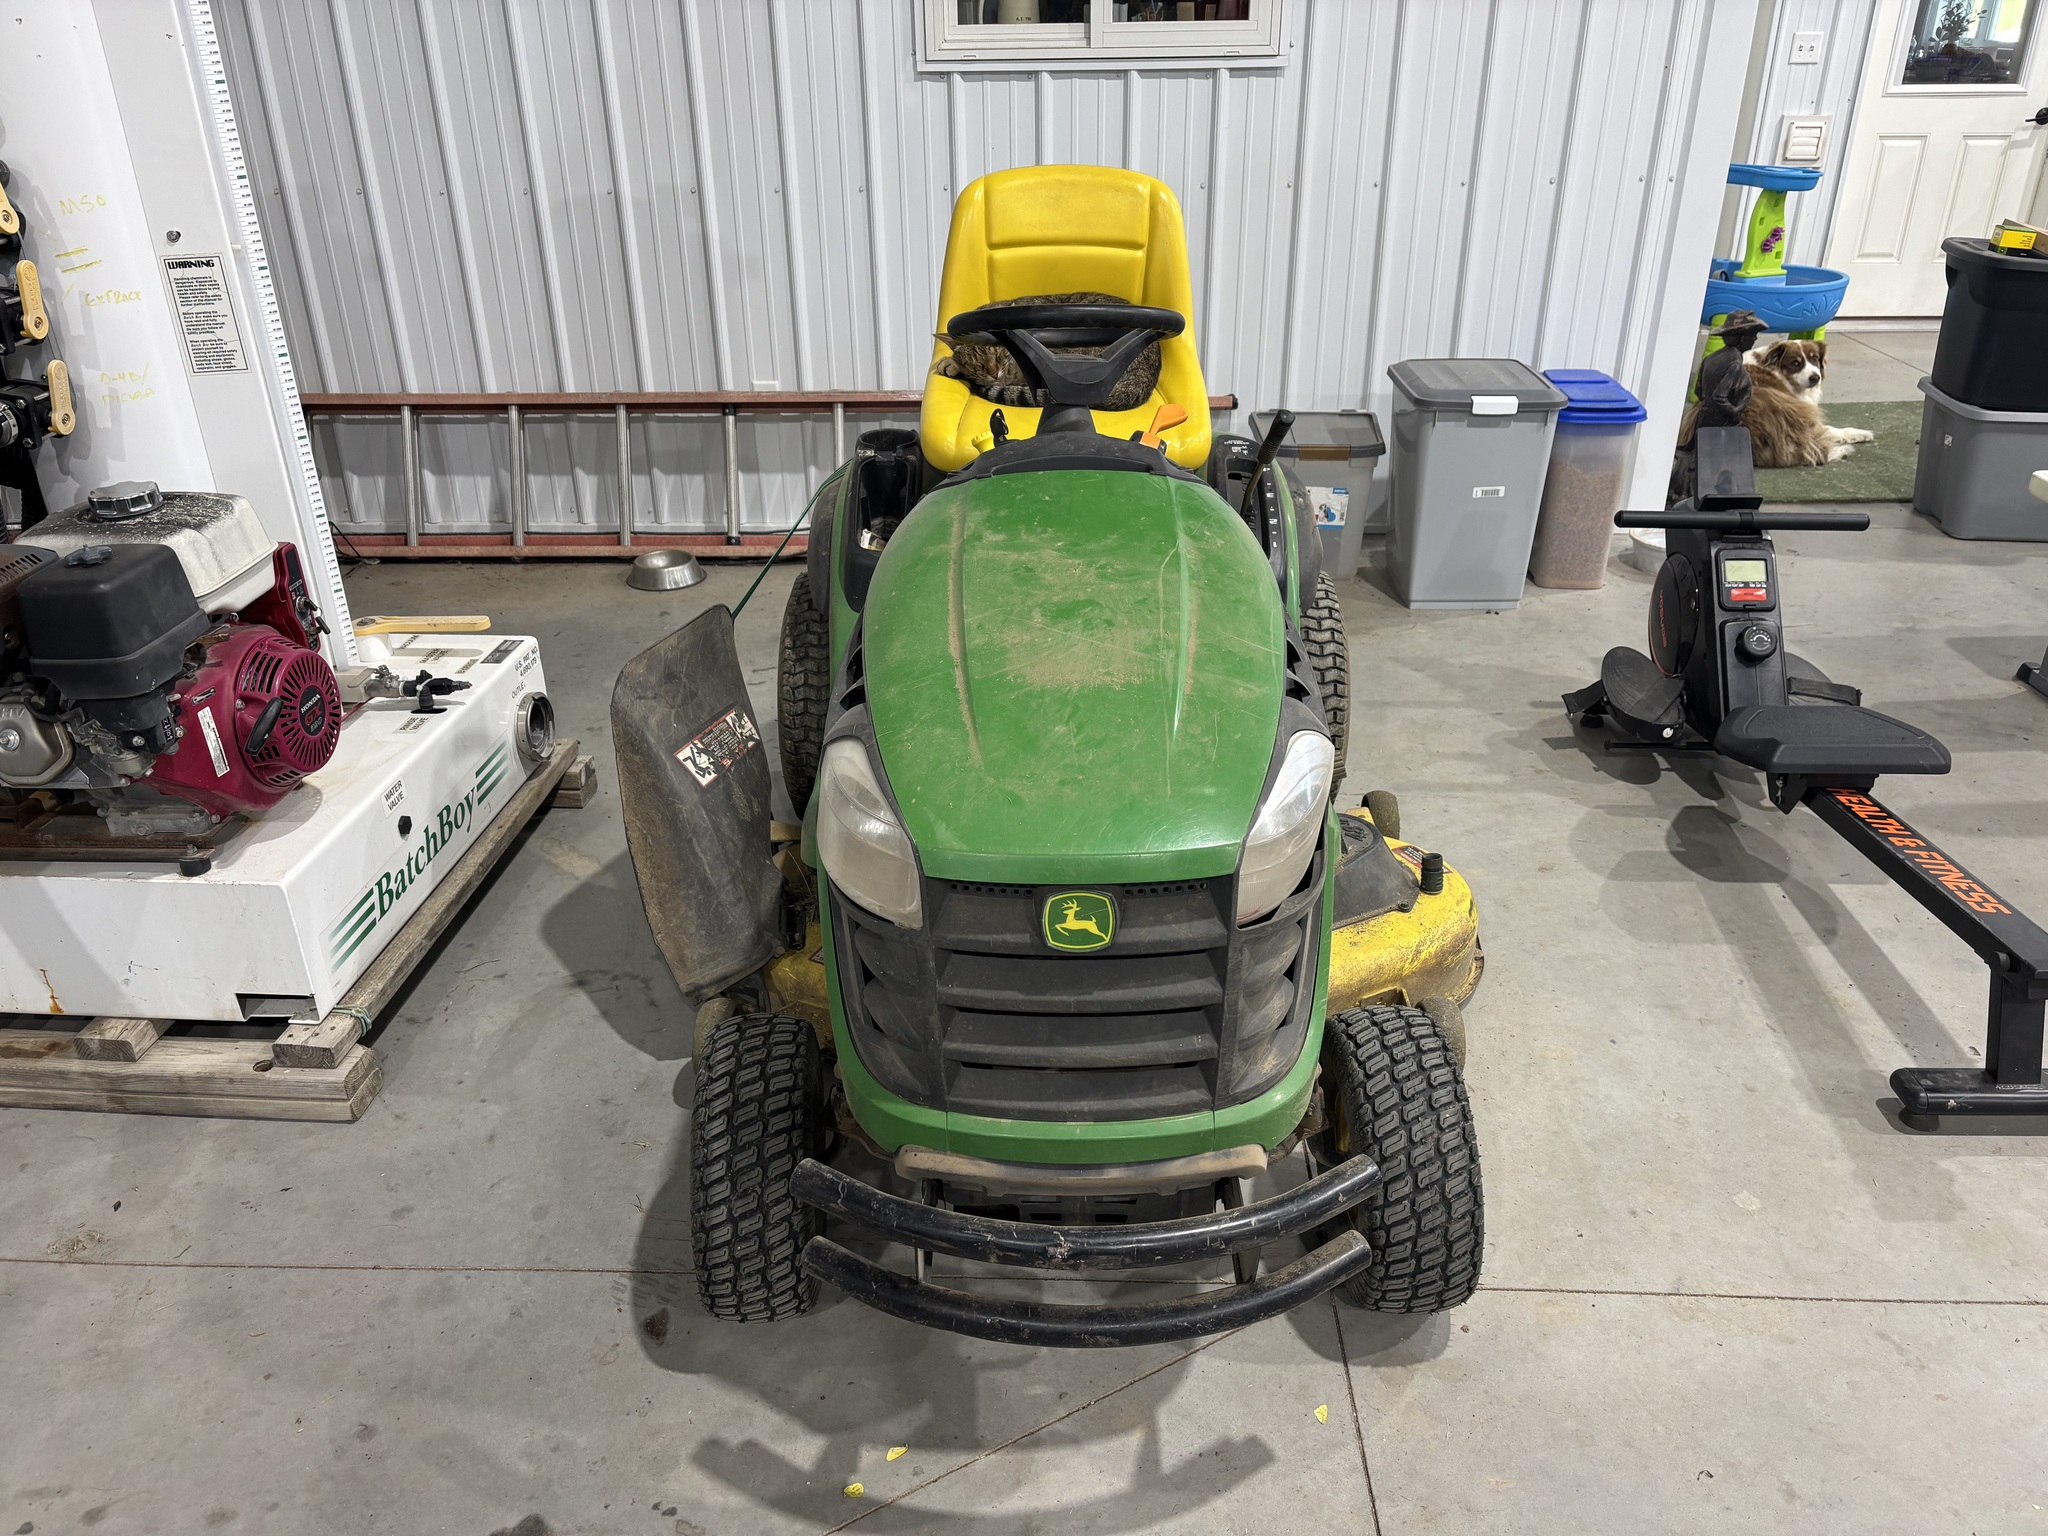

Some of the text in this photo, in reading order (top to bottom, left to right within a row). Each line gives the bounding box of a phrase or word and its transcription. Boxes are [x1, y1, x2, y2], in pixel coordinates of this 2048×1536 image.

[167, 260, 214, 270] WARNING
[300, 693, 321, 713] HONDA
[304, 701, 323, 727] GX
[384, 779, 403, 802] WATER
[387, 790, 405, 811] VALVE
[374, 786, 476, 922] BatchBoy
[1825, 787, 2013, 915] HEALTH & FITNESS
